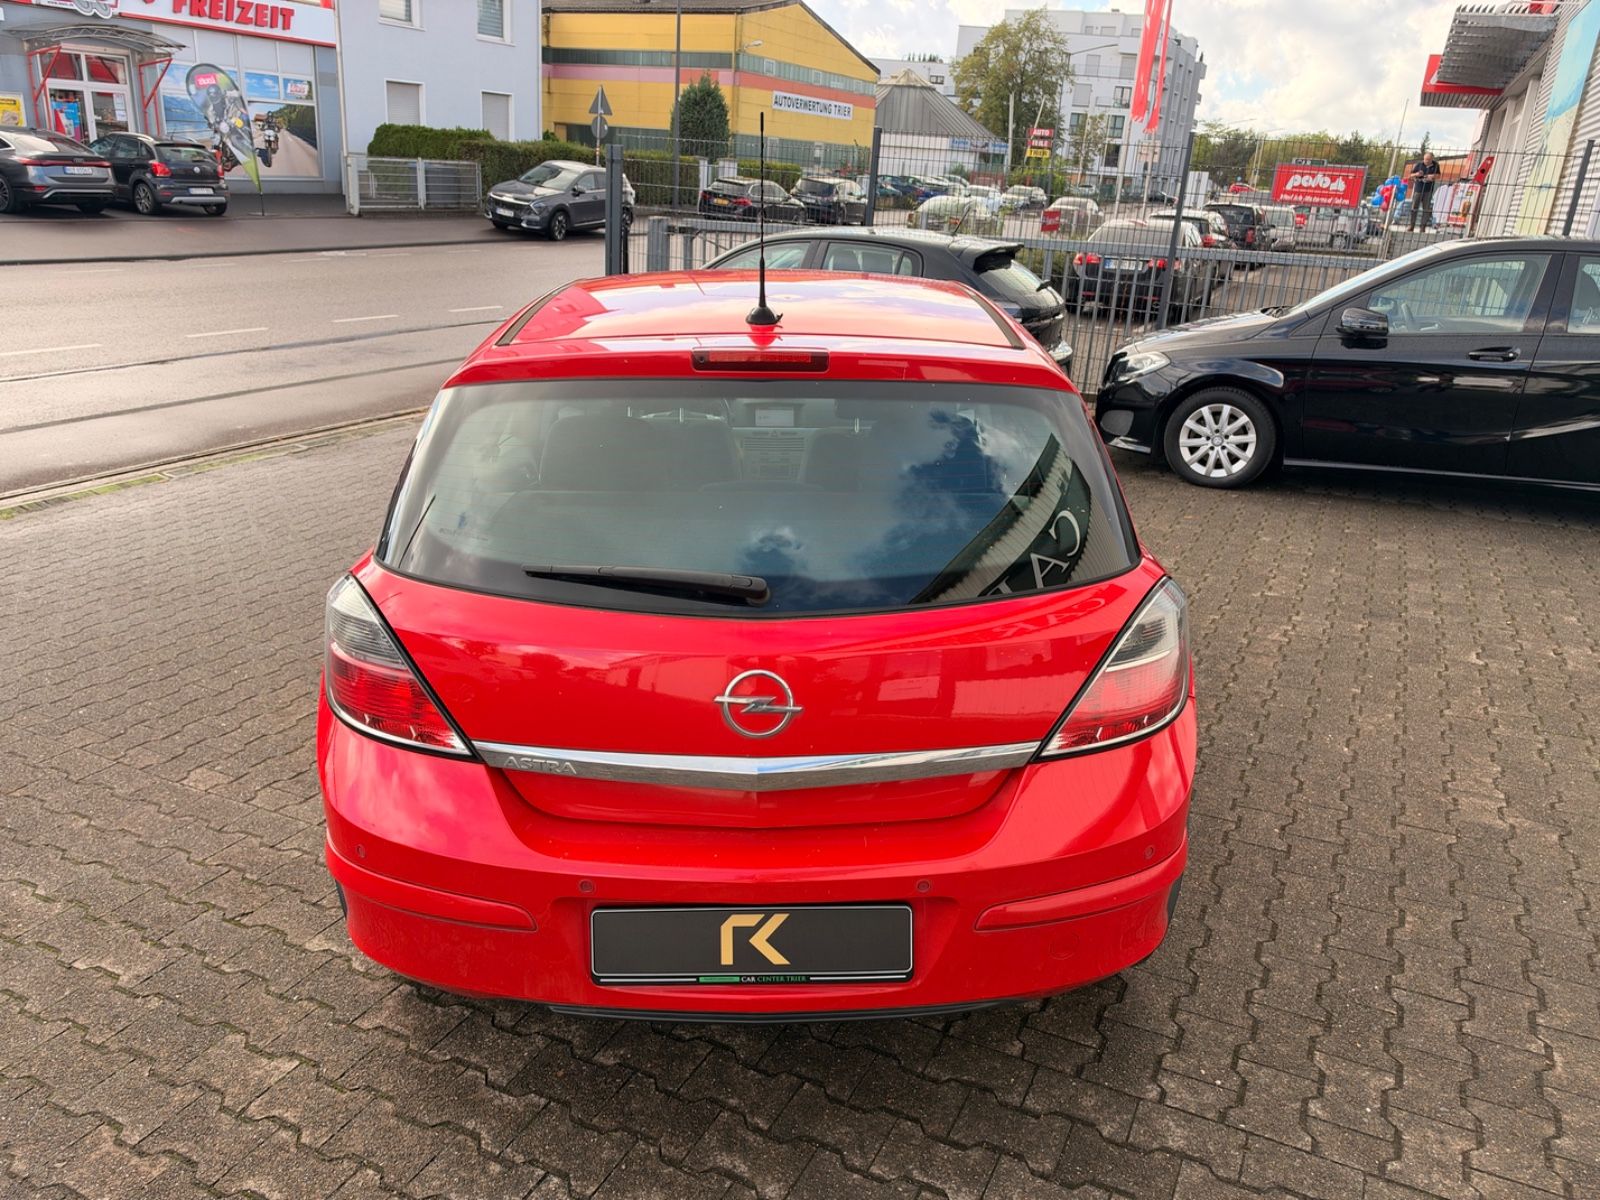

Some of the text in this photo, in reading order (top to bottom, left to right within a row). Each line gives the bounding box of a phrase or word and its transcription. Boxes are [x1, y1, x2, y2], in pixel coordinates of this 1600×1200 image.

[172, 0, 295, 31] FREIZEIT
[774, 94, 851, 117] AUTOVERWERTUNG TRIER
[503, 755, 577, 774] ASTRA
[741, 975, 756, 983] CAR
[757, 975, 785, 983] CENTER
